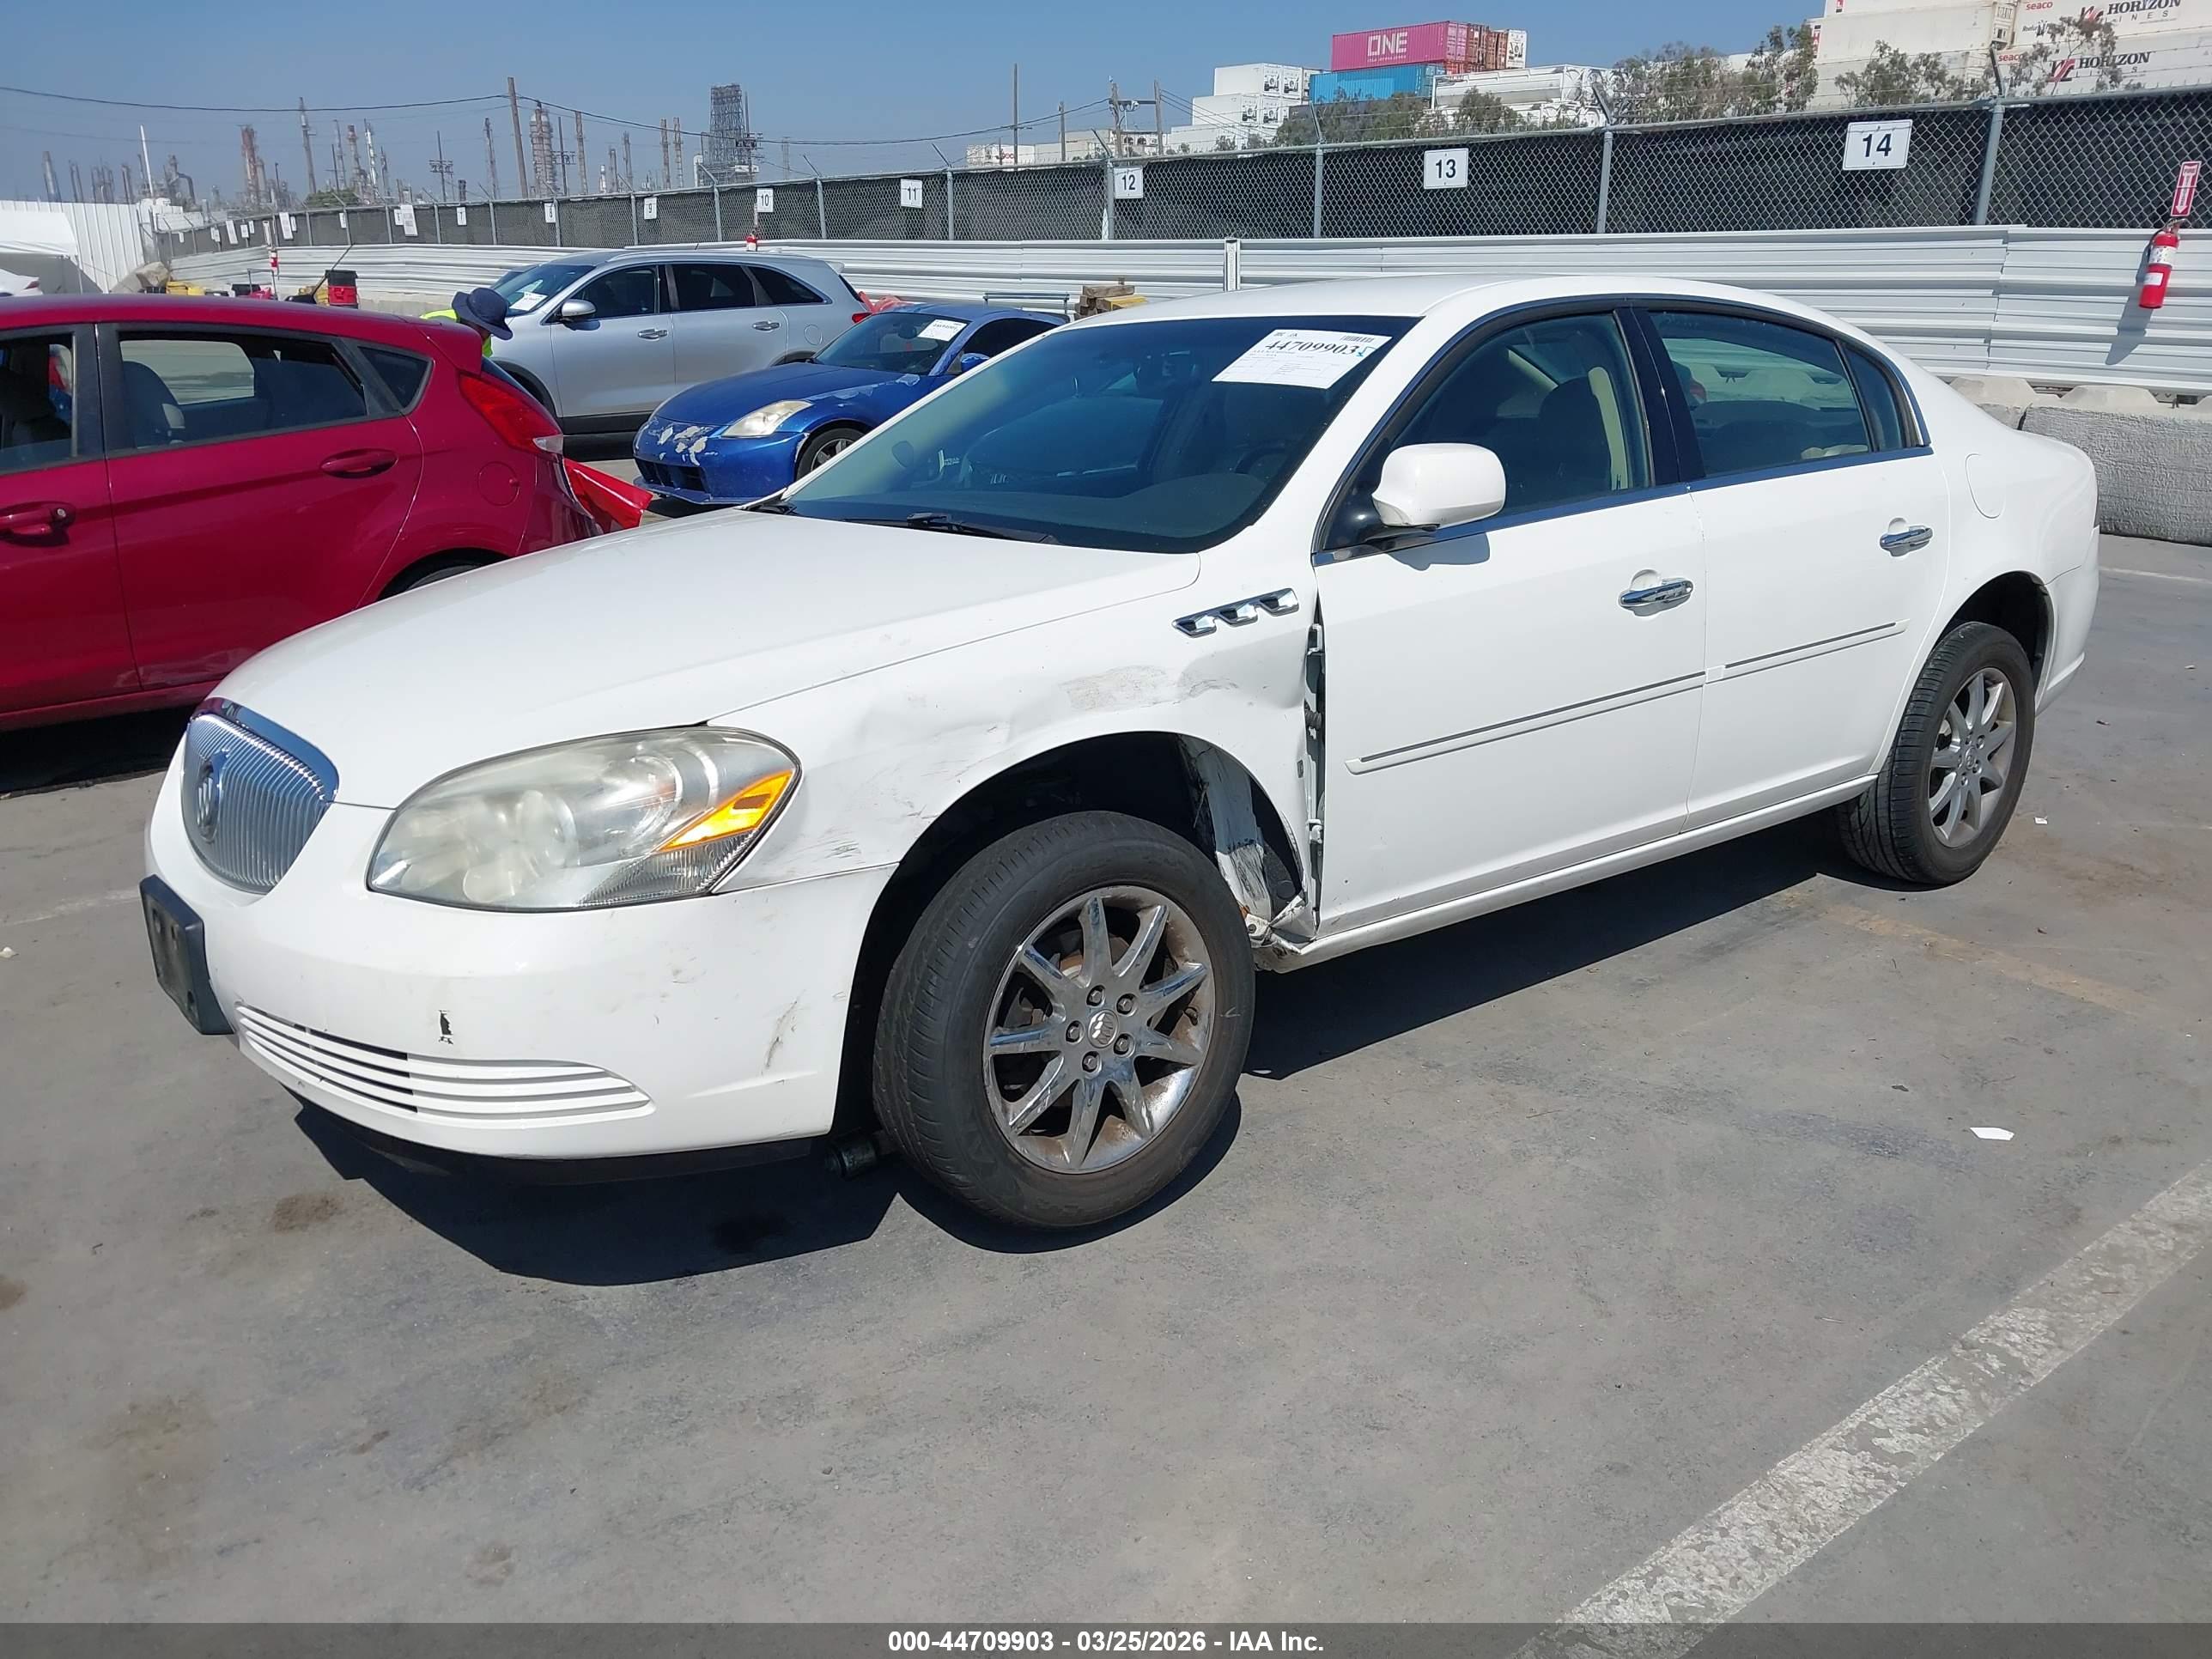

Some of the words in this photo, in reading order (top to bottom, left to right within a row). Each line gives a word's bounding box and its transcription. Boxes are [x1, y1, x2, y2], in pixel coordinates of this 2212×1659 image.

[2027, 2, 2053, 10] seaco
[2107, 0, 2181, 15] HORIZON
[1367, 32, 1407, 57] ONE
[1863, 133, 1893, 158] 14
[1435, 158, 1456, 179] 13
[1121, 174, 1136, 191] 12
[761, 193, 769, 207] 10
[907, 185, 917, 201] 11
[1265, 340, 1360, 356] 44709903
